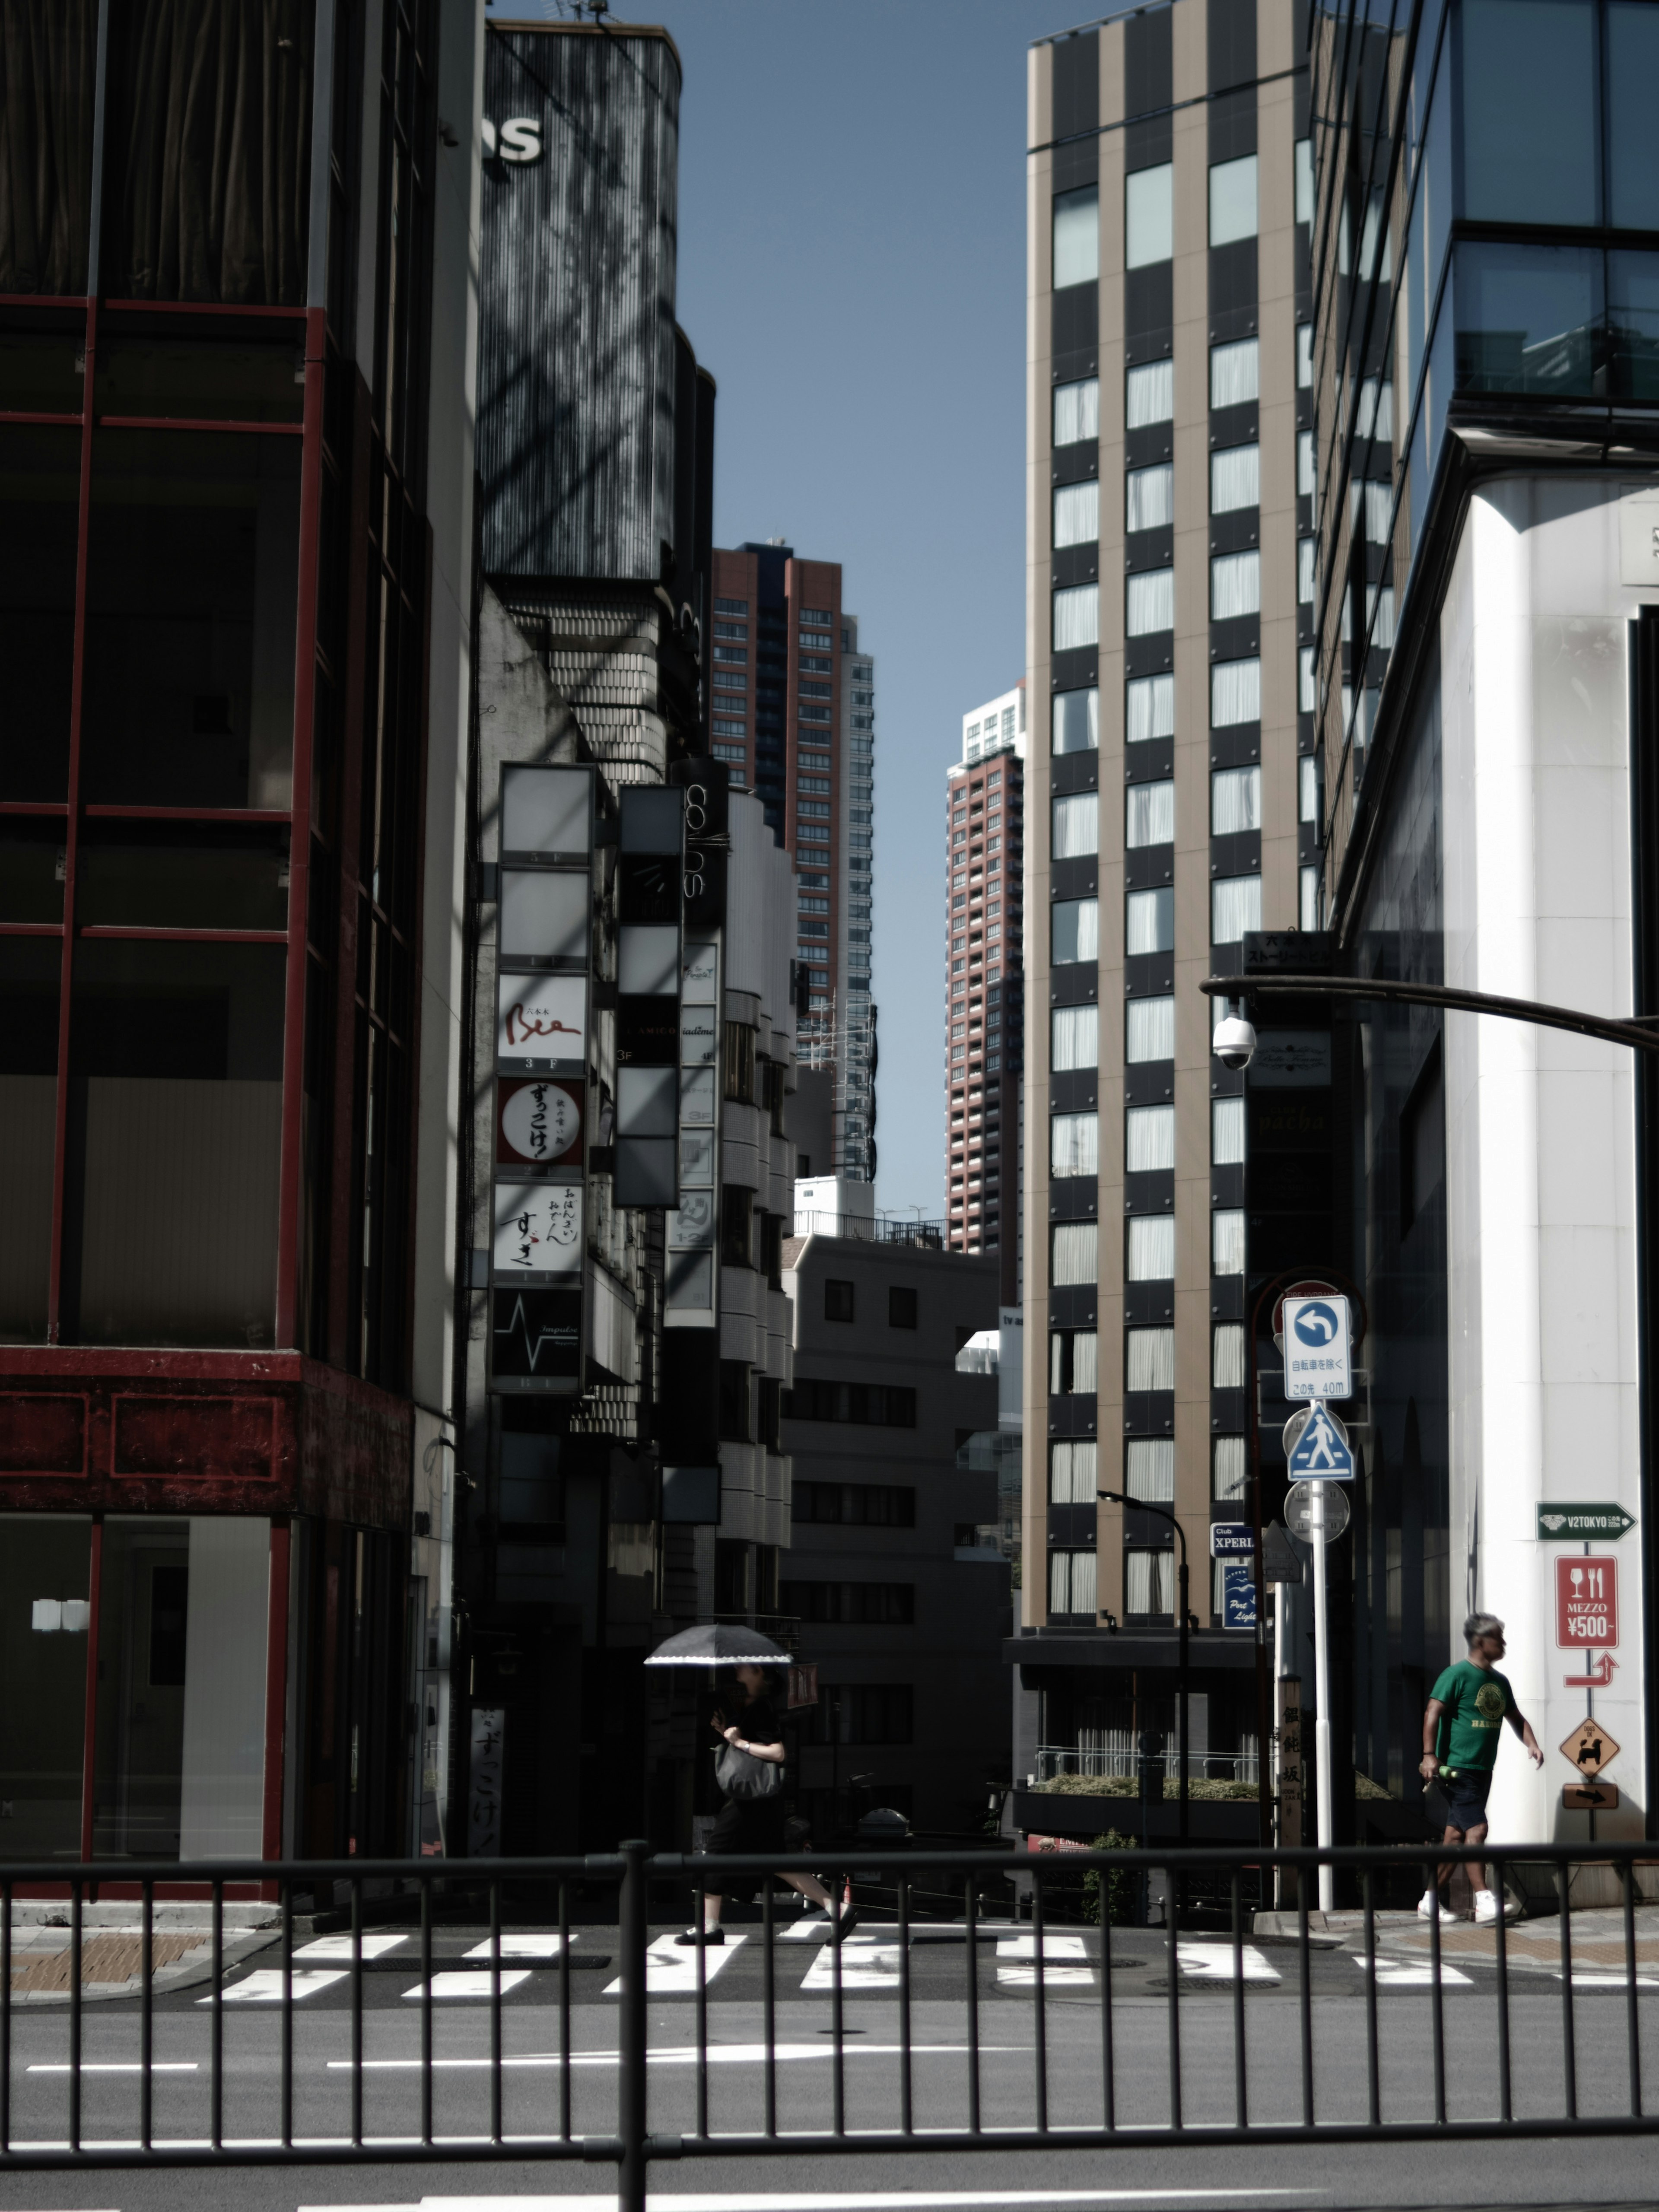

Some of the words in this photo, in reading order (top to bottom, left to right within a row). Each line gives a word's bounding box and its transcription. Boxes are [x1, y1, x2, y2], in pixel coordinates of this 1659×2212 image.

[1266, 935, 1312, 947] 六本木
[617, 1049, 632, 1061] 3F
[525, 1058, 532, 1068] 3
[550, 1059, 557, 1068] F
[688, 1111, 711, 1120] 3F
[1258, 1106, 1326, 1137] pacha
[1251, 1217, 1262, 1227] 4F
[1003, 1315, 1013, 1325] tv
[539, 1325, 578, 1335] Impulse
[1292, 1358, 1343, 1371] 自転車を除く
[1293, 1383, 1314, 1395] この先
[1322, 1382, 1344, 1395] 40m
[1567, 1516, 1607, 1528] V2TOKYO
[1215, 1538, 1254, 1548] XPERI
[1229, 1599, 1248, 1609] Port
[1567, 1603, 1607, 1613] MEZZO
